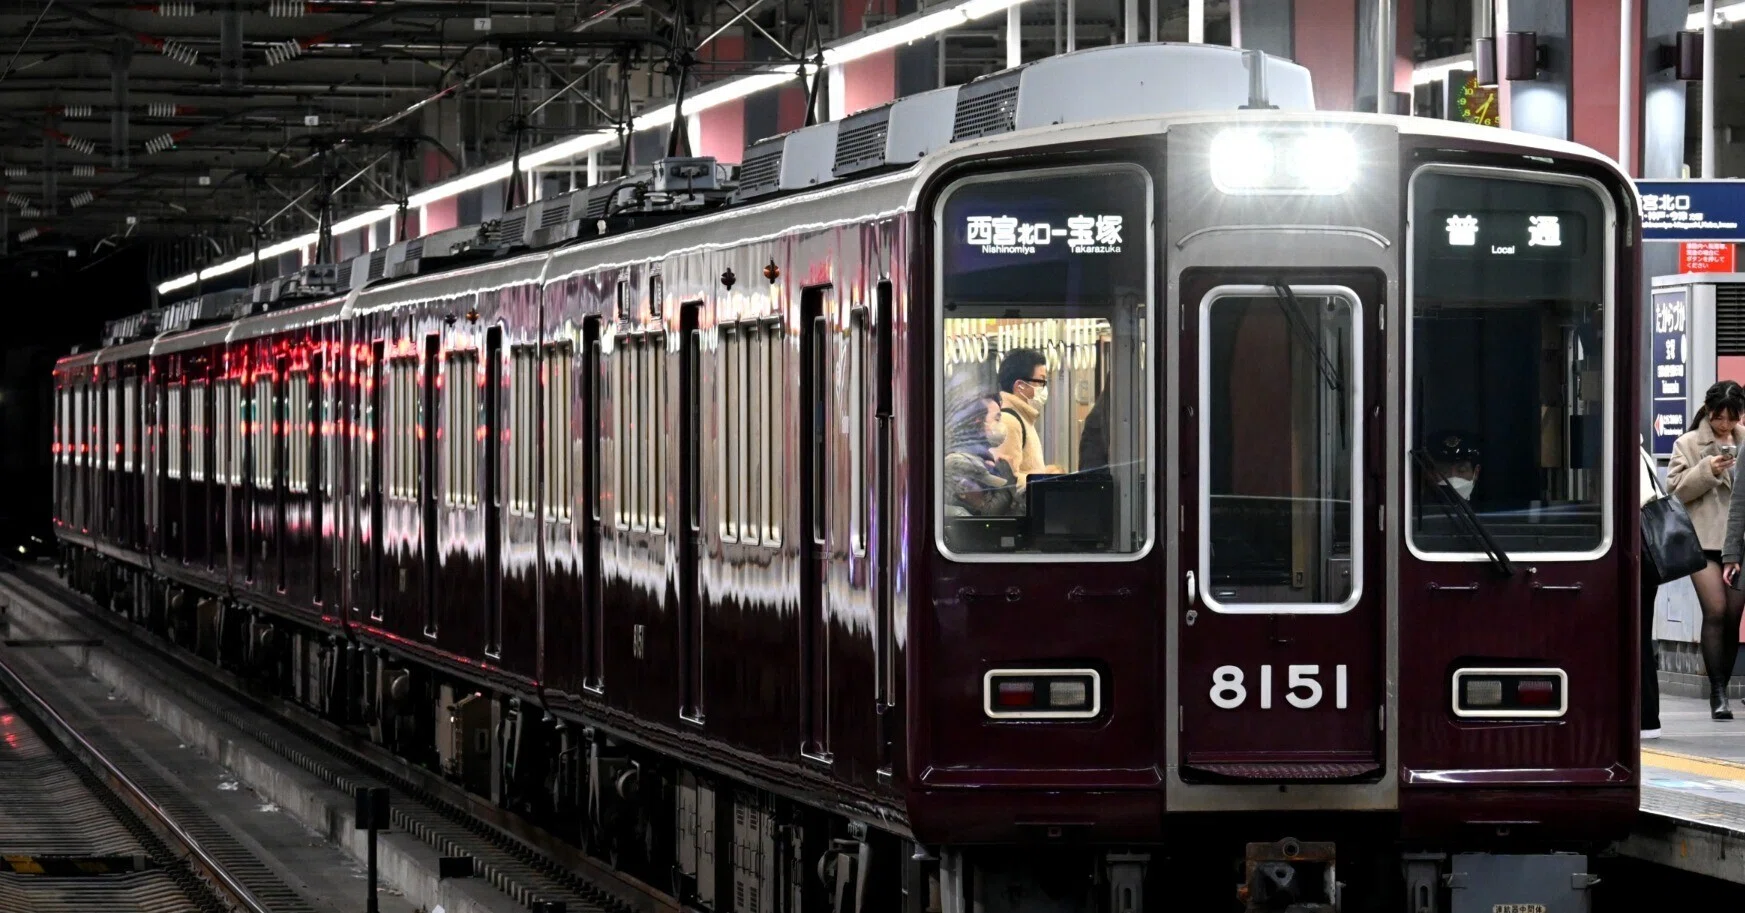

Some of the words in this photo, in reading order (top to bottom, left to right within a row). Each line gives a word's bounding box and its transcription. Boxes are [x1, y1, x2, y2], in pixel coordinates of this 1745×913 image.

[1640, 194, 1690, 211] 宮北口
[982, 244, 1035, 254] Nishinomiya
[1071, 244, 1121, 253] Takarazuka
[1491, 245, 1515, 254] Local
[1210, 664, 1347, 709] 8151
